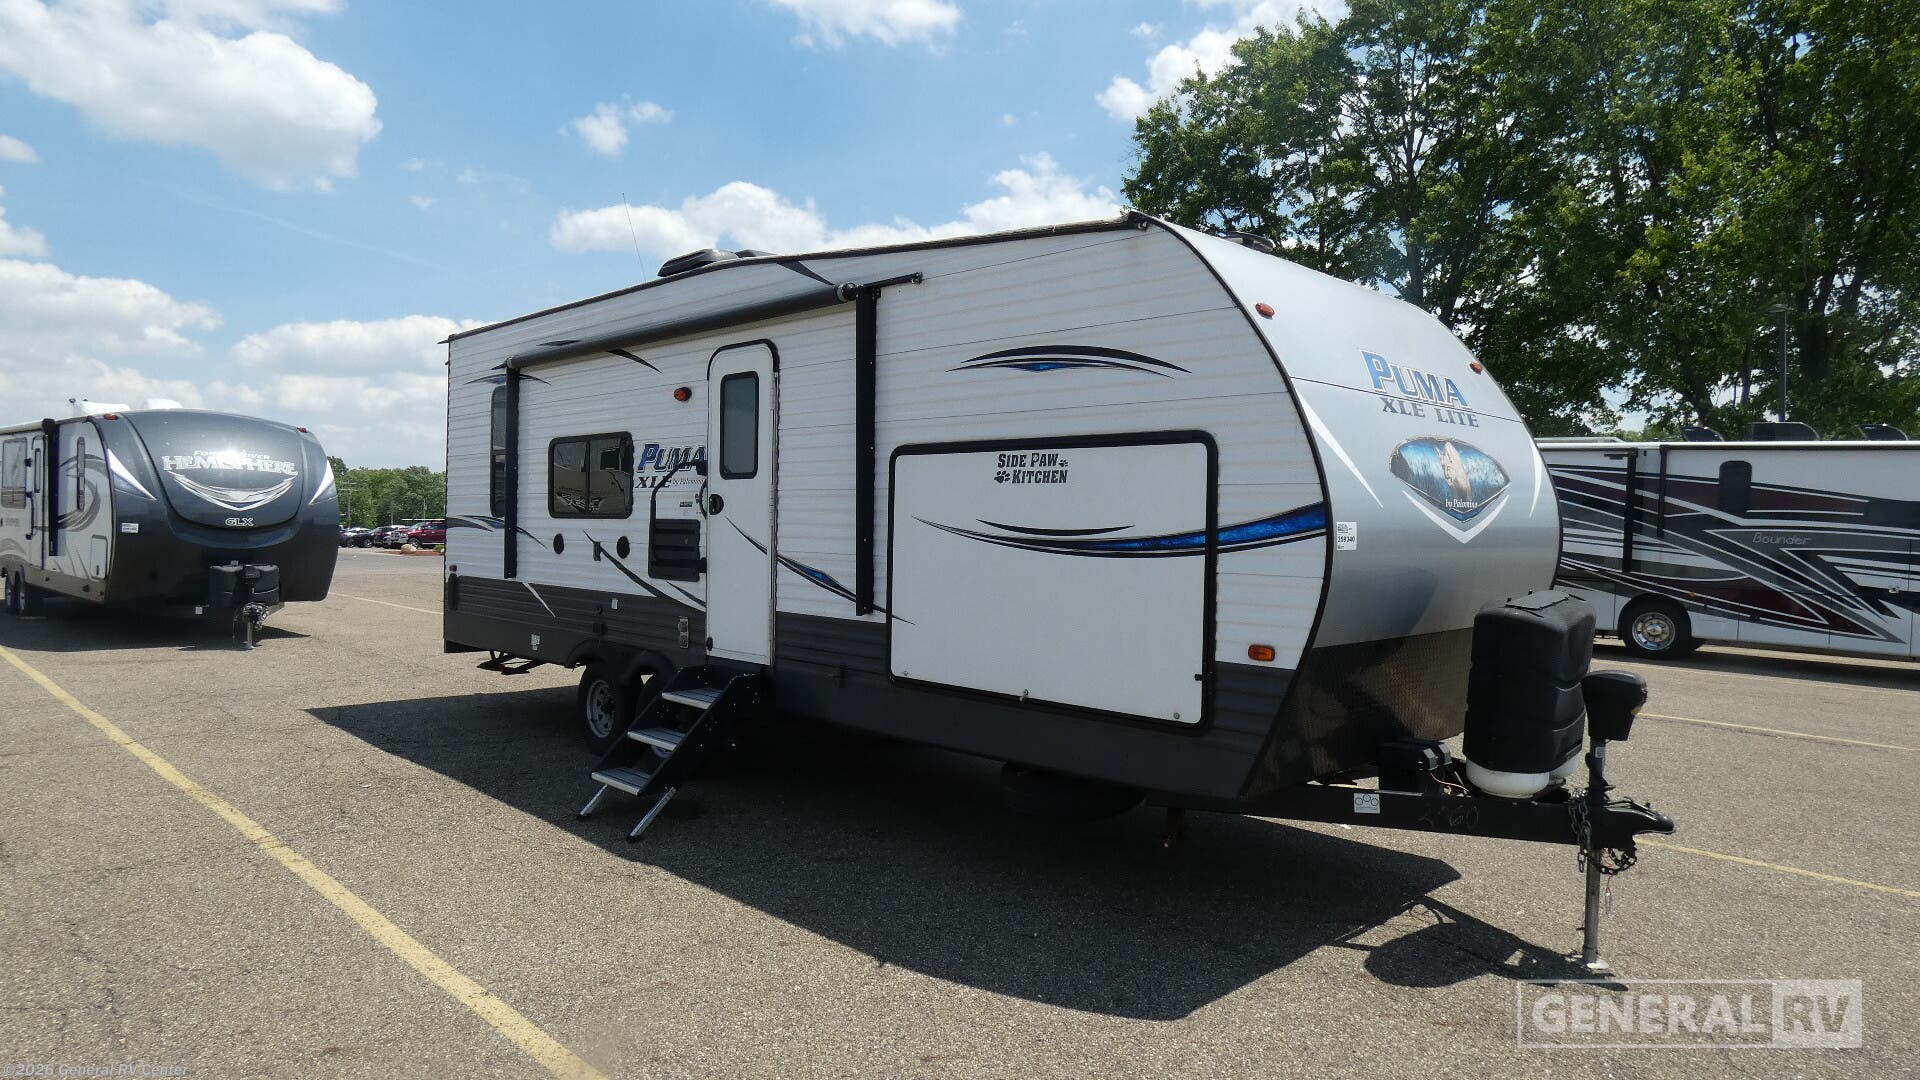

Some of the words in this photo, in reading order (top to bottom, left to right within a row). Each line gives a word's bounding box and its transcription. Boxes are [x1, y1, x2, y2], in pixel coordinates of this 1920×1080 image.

[1360, 349, 1471, 409] PUMA
[1382, 397, 1425, 418] XLE
[1434, 407, 1479, 428] LITE
[997, 453, 1027, 468] SIDE
[1030, 452, 1058, 467] PAW
[1012, 469, 1068, 484] KITCHEN
[1445, 498, 1453, 510] by
[225, 517, 254, 527] GLX
[1752, 532, 1812, 545] Bounder
